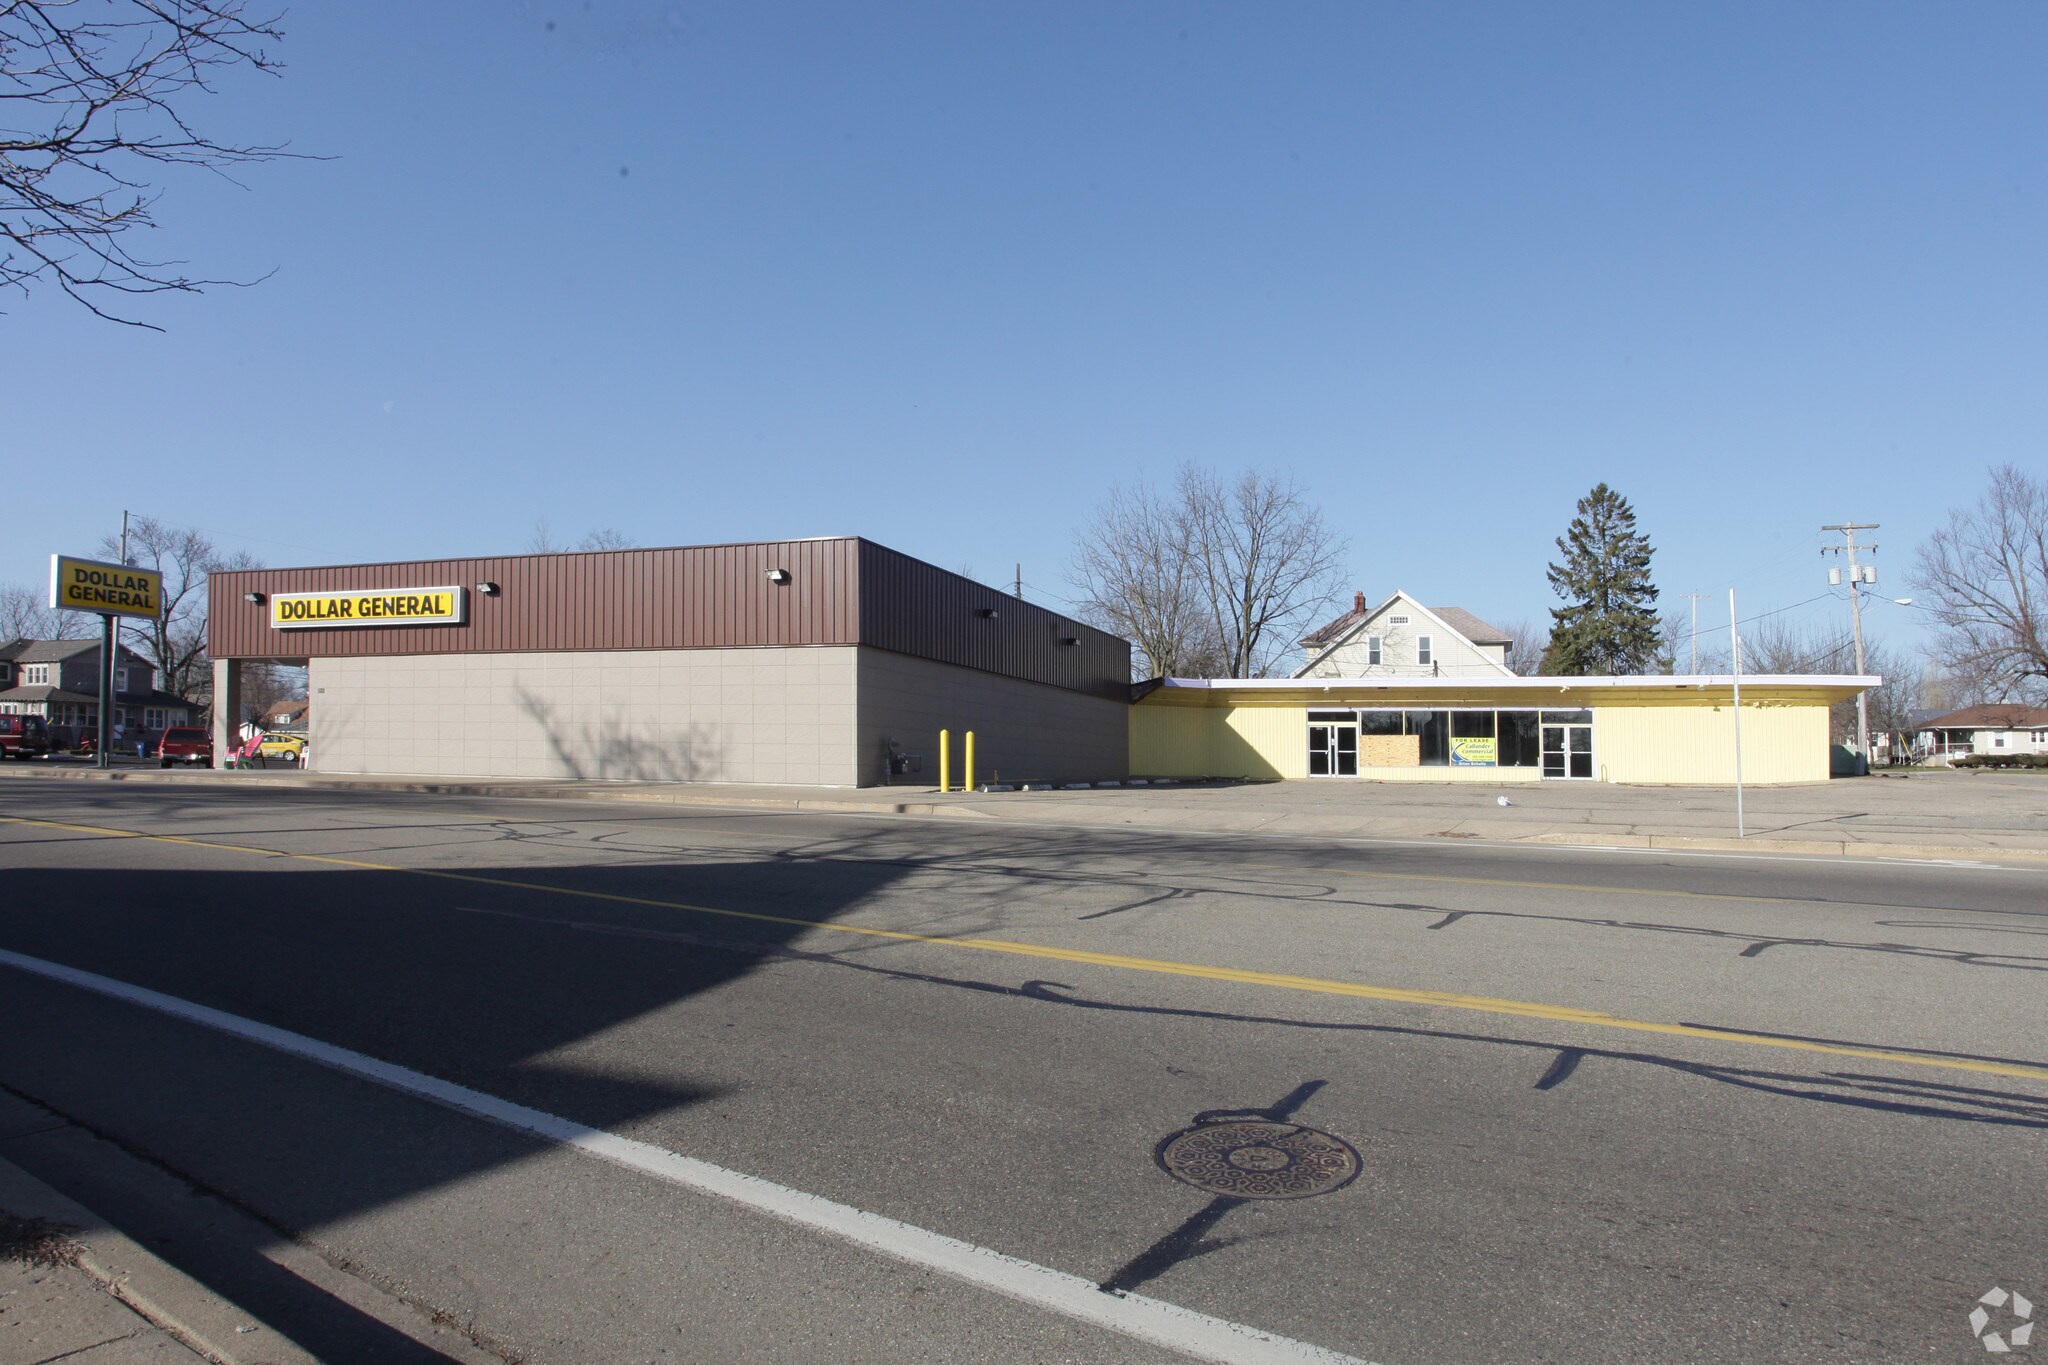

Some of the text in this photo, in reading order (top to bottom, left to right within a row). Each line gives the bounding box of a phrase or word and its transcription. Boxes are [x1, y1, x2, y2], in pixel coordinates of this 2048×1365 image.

[74, 568, 149, 592] DOLLAR
[68, 585, 154, 608] GENERAL
[280, 595, 445, 619] DOLLAR GENERAL
